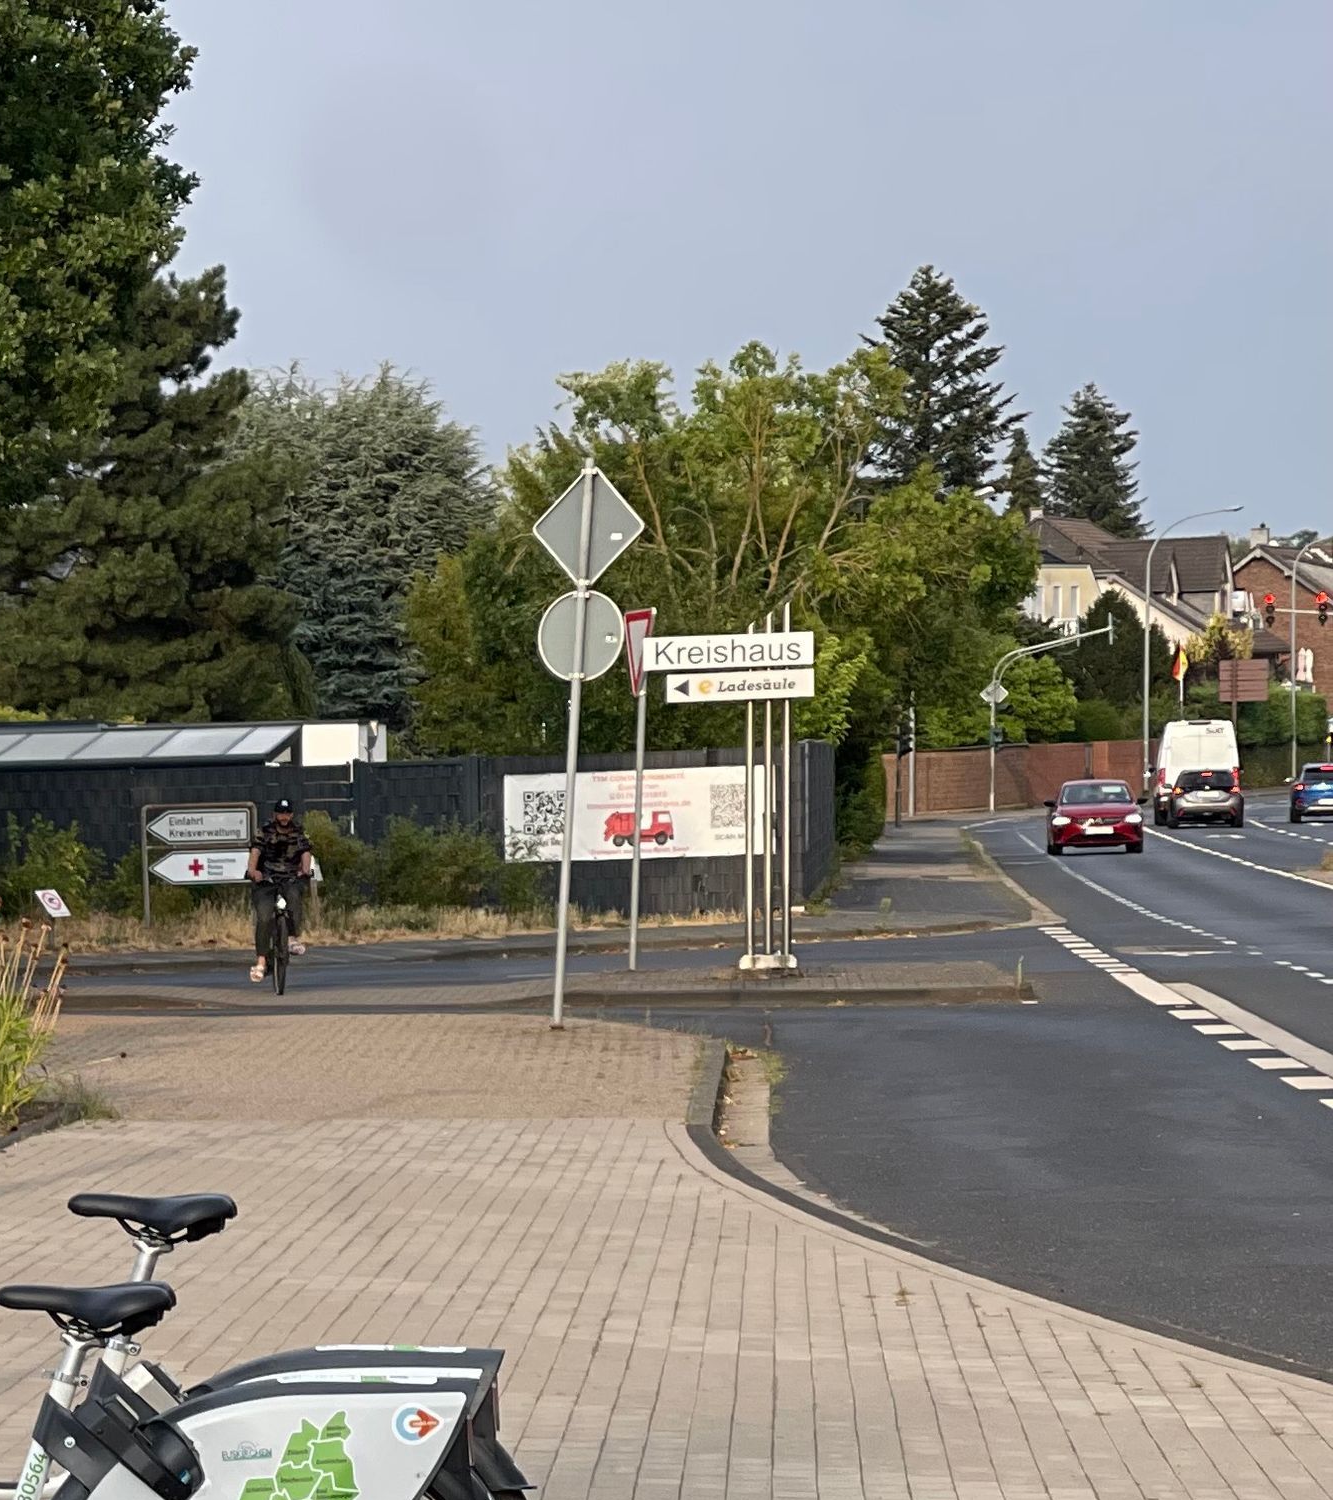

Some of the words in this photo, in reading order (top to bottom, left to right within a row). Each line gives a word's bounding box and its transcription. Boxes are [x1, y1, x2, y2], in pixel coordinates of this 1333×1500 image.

[655, 639, 802, 664] Kreishaus
[718, 679, 796, 693] Ladesäule
[169, 817, 203, 826] Einfahrt
[169, 828, 241, 838] Kreisverwaltung
